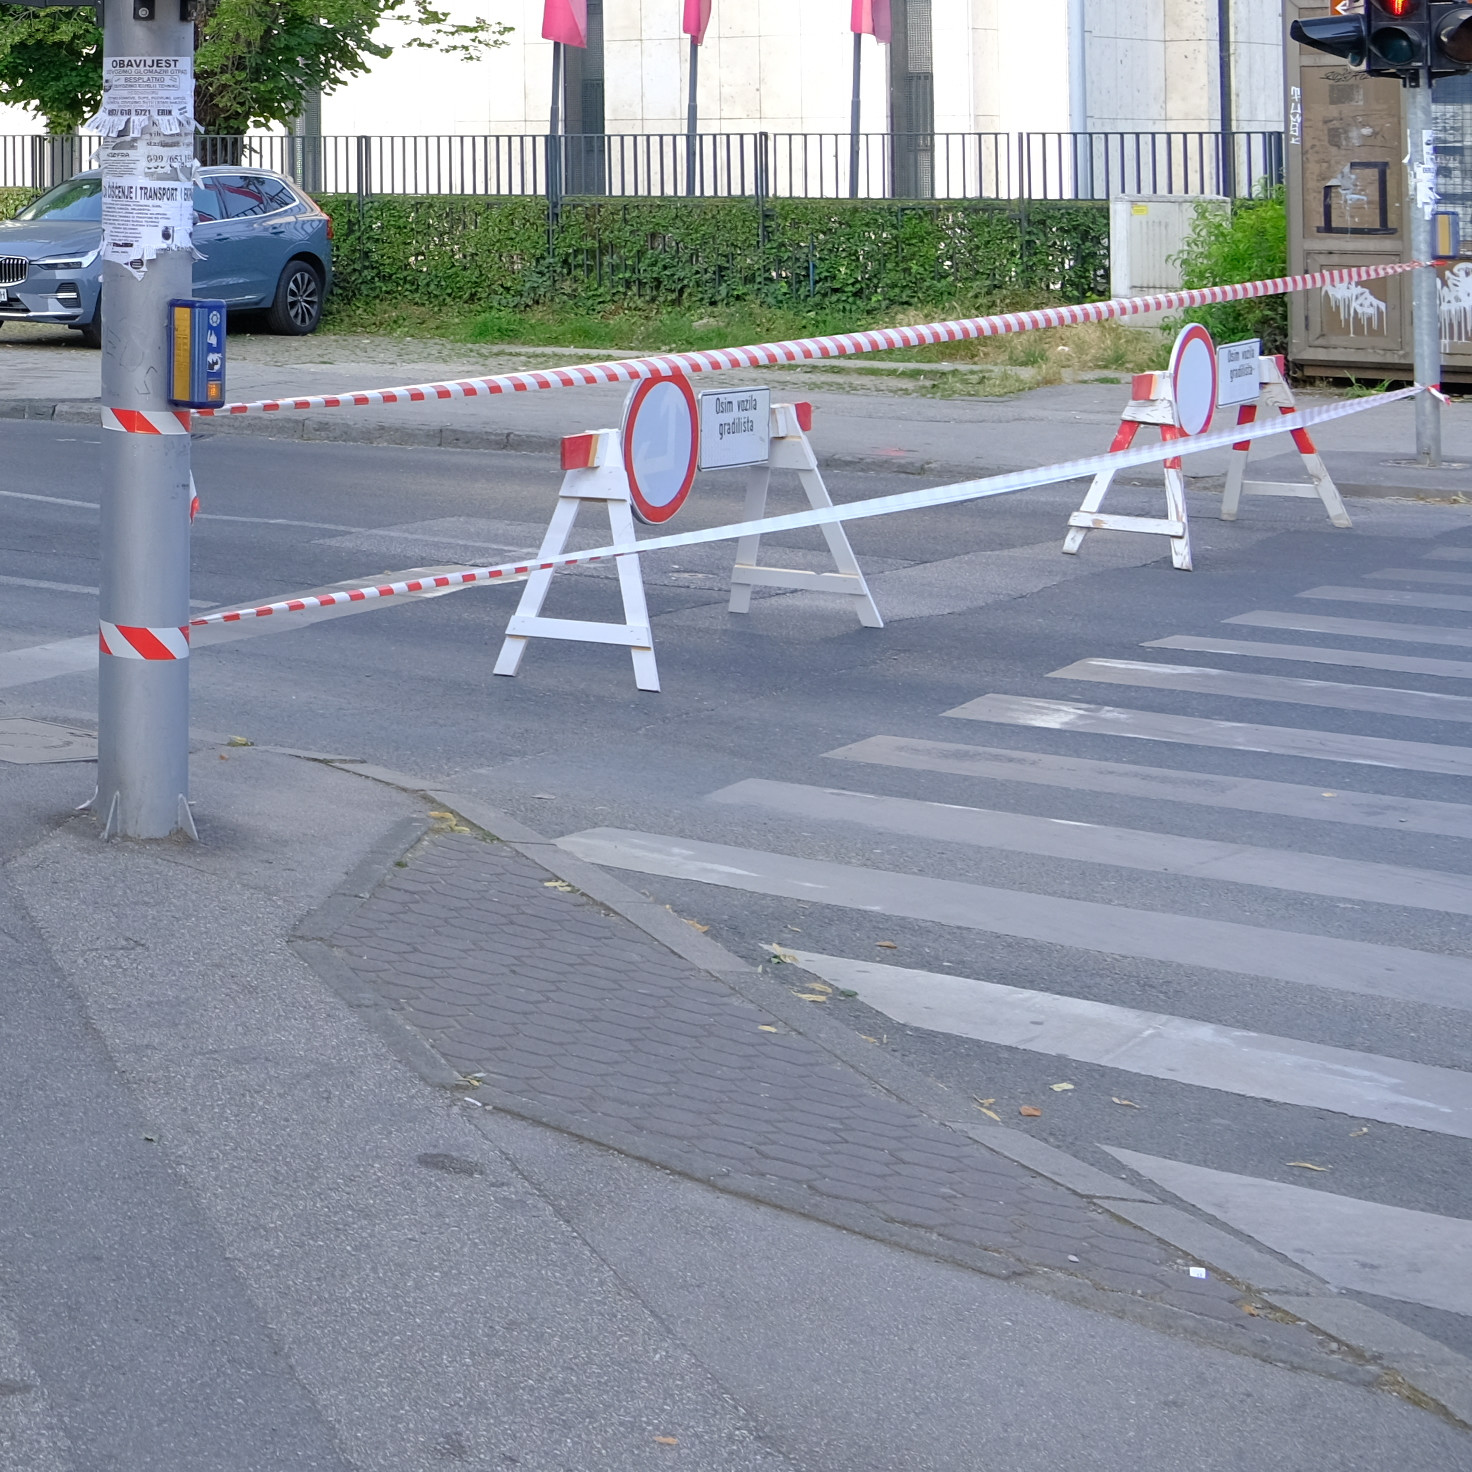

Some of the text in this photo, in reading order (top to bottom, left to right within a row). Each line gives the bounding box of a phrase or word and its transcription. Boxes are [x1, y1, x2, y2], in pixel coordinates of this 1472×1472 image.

[111, 59, 179, 69] OBAVIJEST
[139, 186, 178, 202] TRANSPORT
[716, 394, 757, 414] Osim vozila
[719, 416, 754, 440] gradilišta
